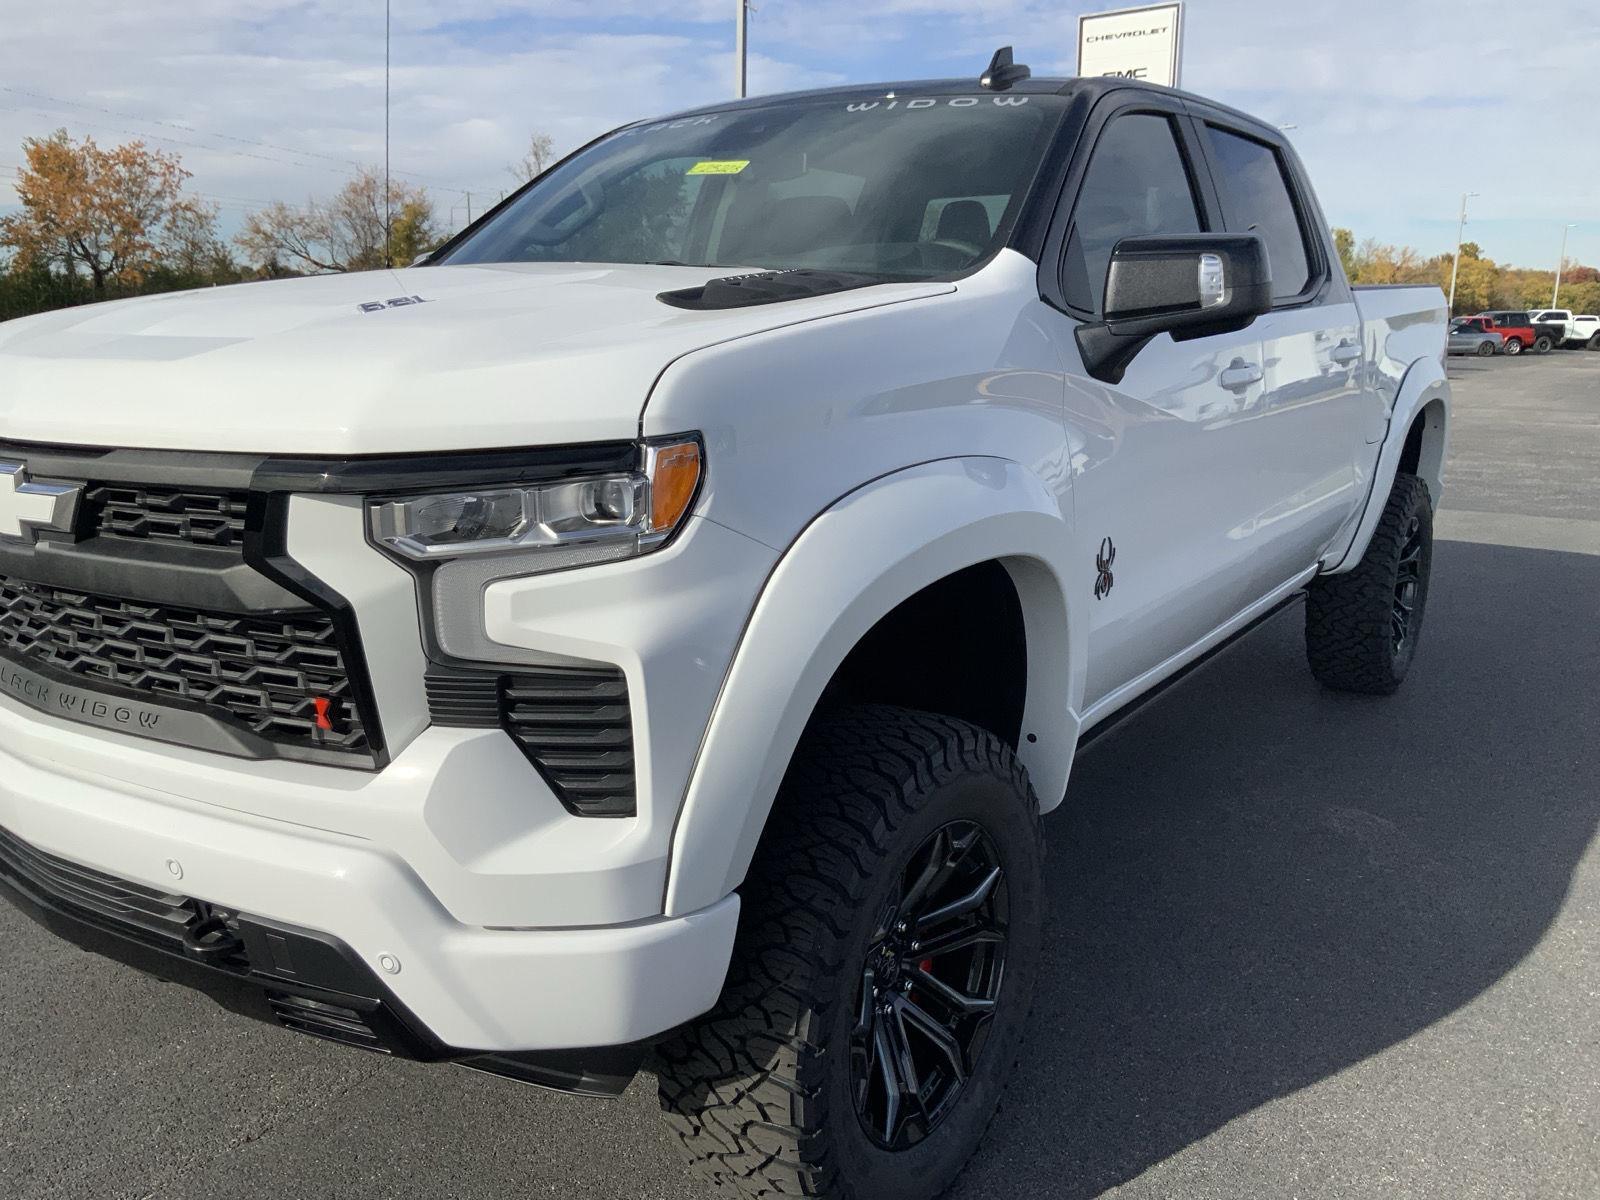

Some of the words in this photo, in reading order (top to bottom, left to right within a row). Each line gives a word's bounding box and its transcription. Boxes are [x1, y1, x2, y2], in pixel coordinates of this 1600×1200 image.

[1086, 27, 1168, 43] CHEVROLET
[846, 96, 1029, 112] WIDOW
[0, 666, 49, 701] LACK
[59, 693, 160, 729] WIDOW
